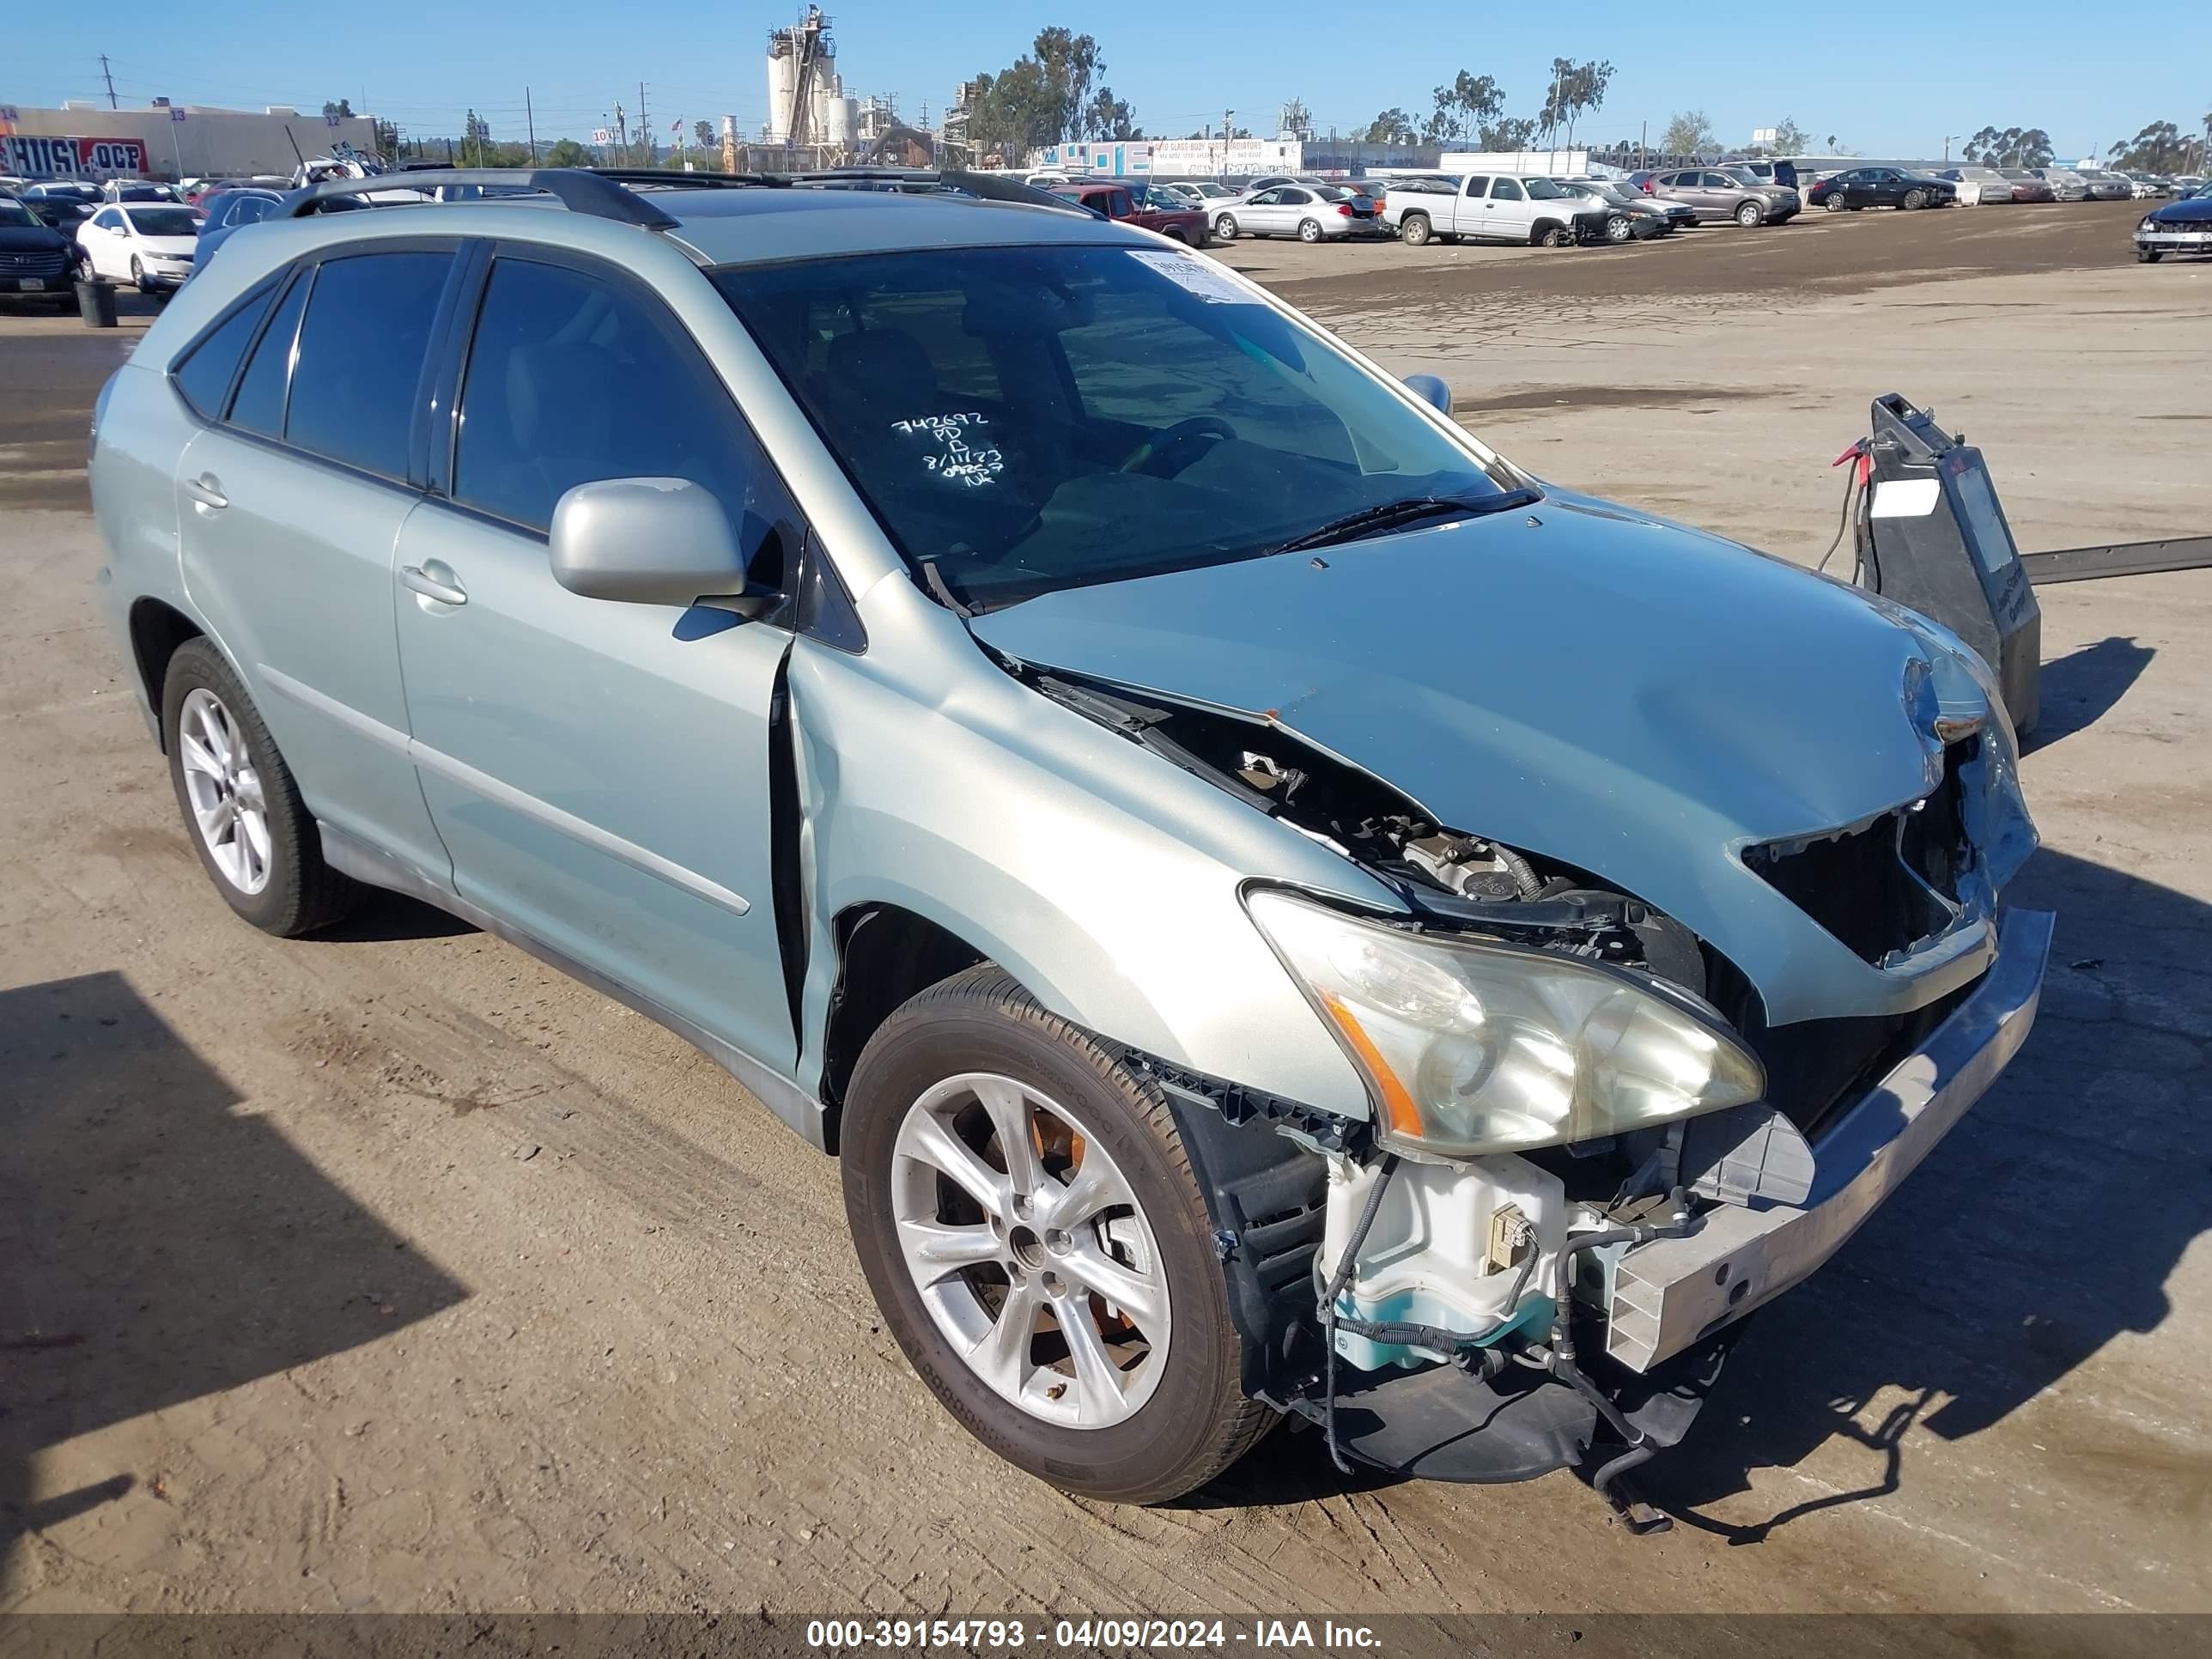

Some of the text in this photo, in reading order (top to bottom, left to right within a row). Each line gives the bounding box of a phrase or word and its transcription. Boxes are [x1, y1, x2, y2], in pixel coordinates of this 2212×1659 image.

[172, 111, 185, 121] 13
[326, 117, 340, 125] 12
[477, 124, 489, 134] 11
[593, 131, 605, 141] 10
[707, 135, 713, 145] 9
[787, 139, 793, 149] 8
